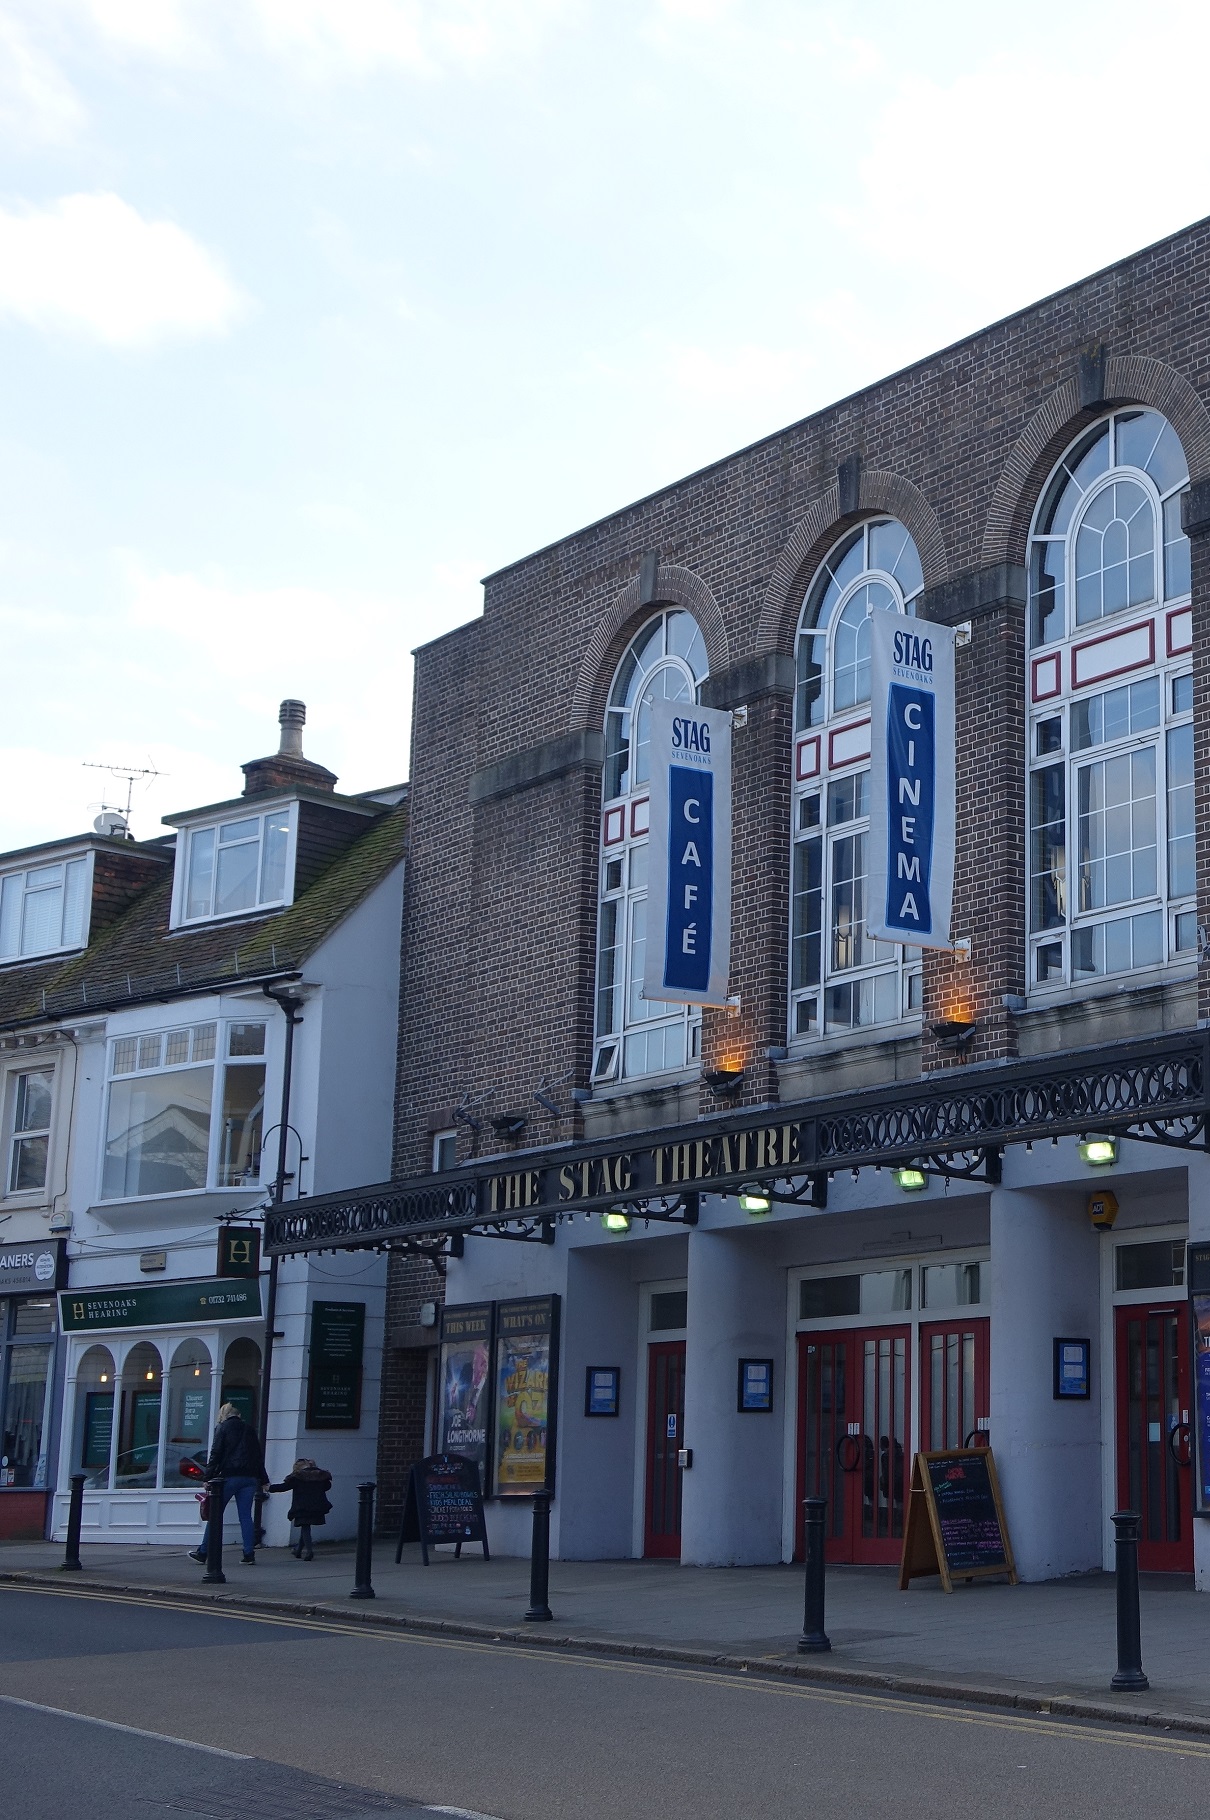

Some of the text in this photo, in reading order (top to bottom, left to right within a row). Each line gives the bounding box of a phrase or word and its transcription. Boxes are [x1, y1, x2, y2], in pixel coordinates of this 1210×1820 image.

[893, 629, 933, 672] STAG
[893, 667, 933, 684] SEVENOAKS
[672, 716, 711, 753] STAG
[671, 751, 712, 765] SEVENOAKS
[897, 703, 921, 921] CINEMA
[681, 798, 701, 955] CAFÉ
[488, 1124, 801, 1212] THE STAG THEATRE
[1092, 1203, 1103, 1213] ADT
[228, 1239, 251, 1263] H
[1195, 1253, 1210, 1262] STAG
[87, 1299, 137, 1310] SEVENOAKS
[88, 1310, 128, 1319] HEARING
[503, 1313, 546, 1329] WHAT'S ON
[446, 1319, 487, 1334] THIS WEEK
[451, 1414, 462, 1428] JOE
[447, 1428, 486, 1444] LONGTHORNE
